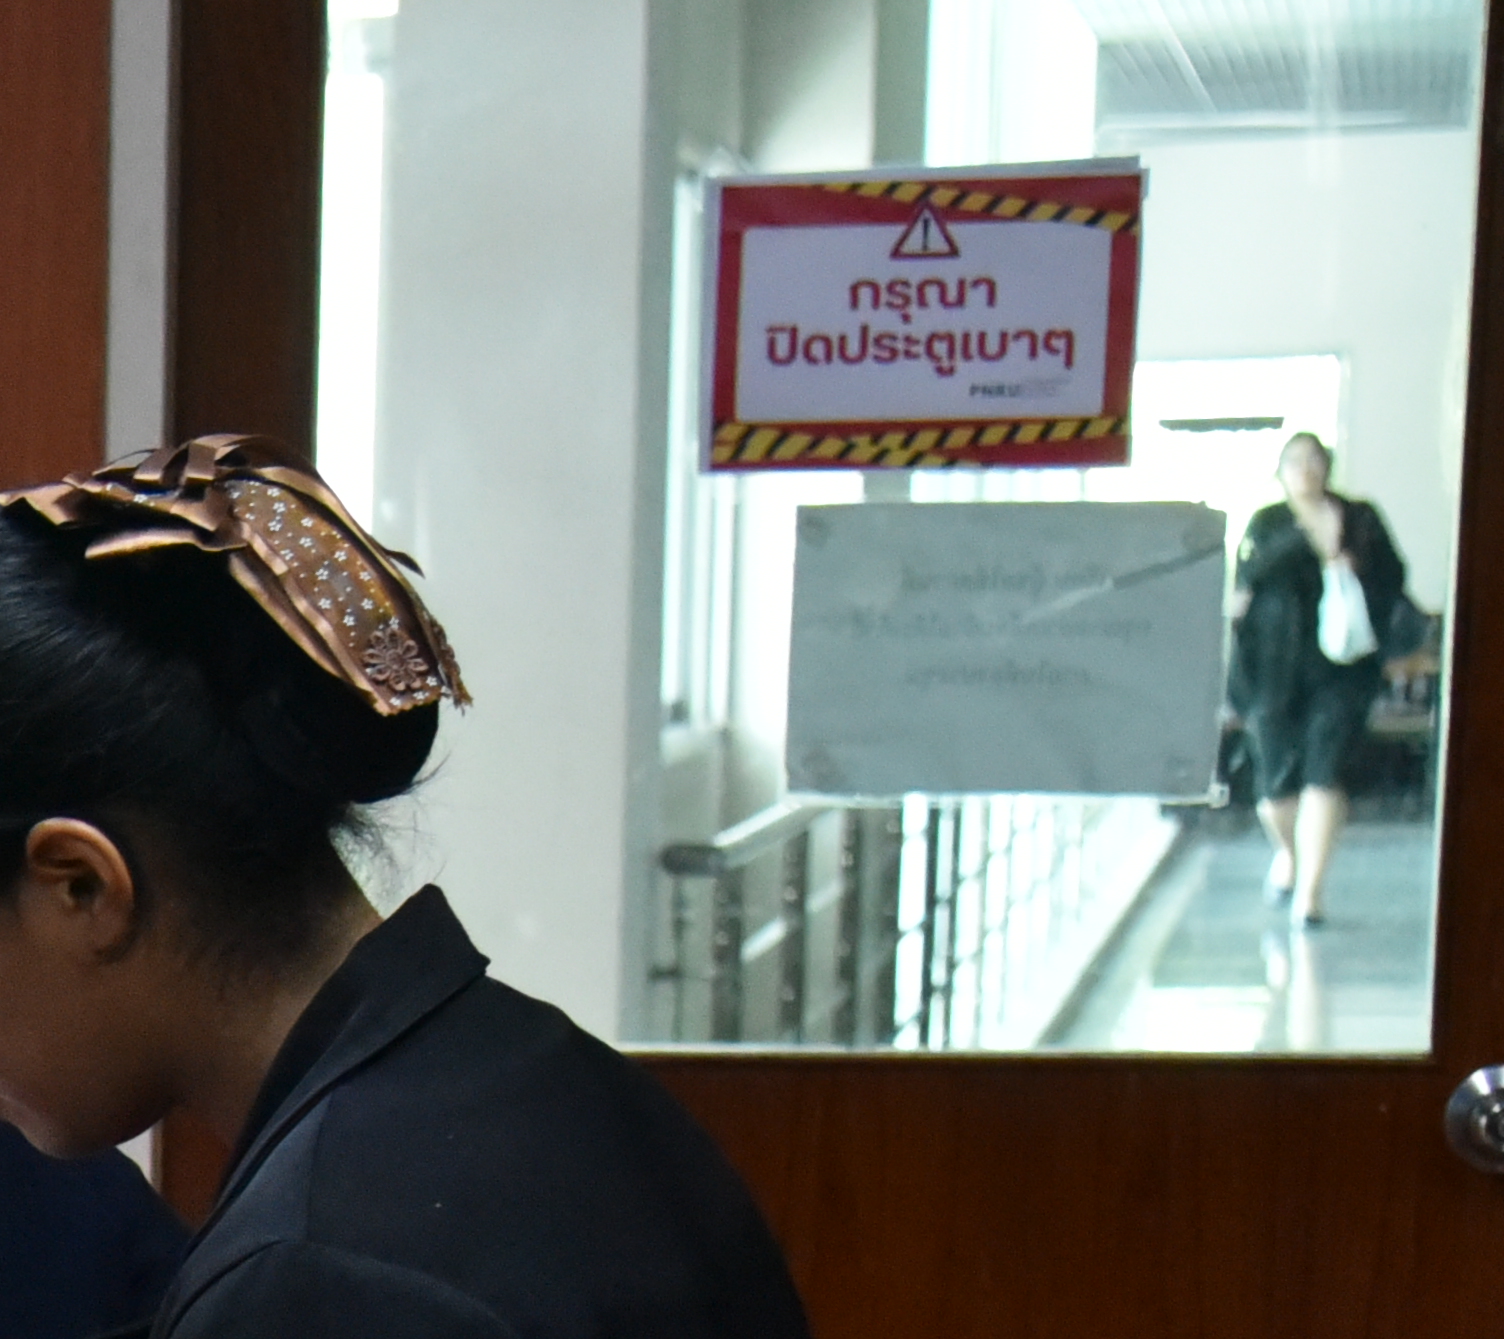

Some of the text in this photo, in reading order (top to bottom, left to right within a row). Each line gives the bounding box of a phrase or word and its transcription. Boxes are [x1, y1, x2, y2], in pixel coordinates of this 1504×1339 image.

[848, 276, 998, 324] กรุณา
[765, 322, 1075, 377] ปิดประตูเบาๆ
